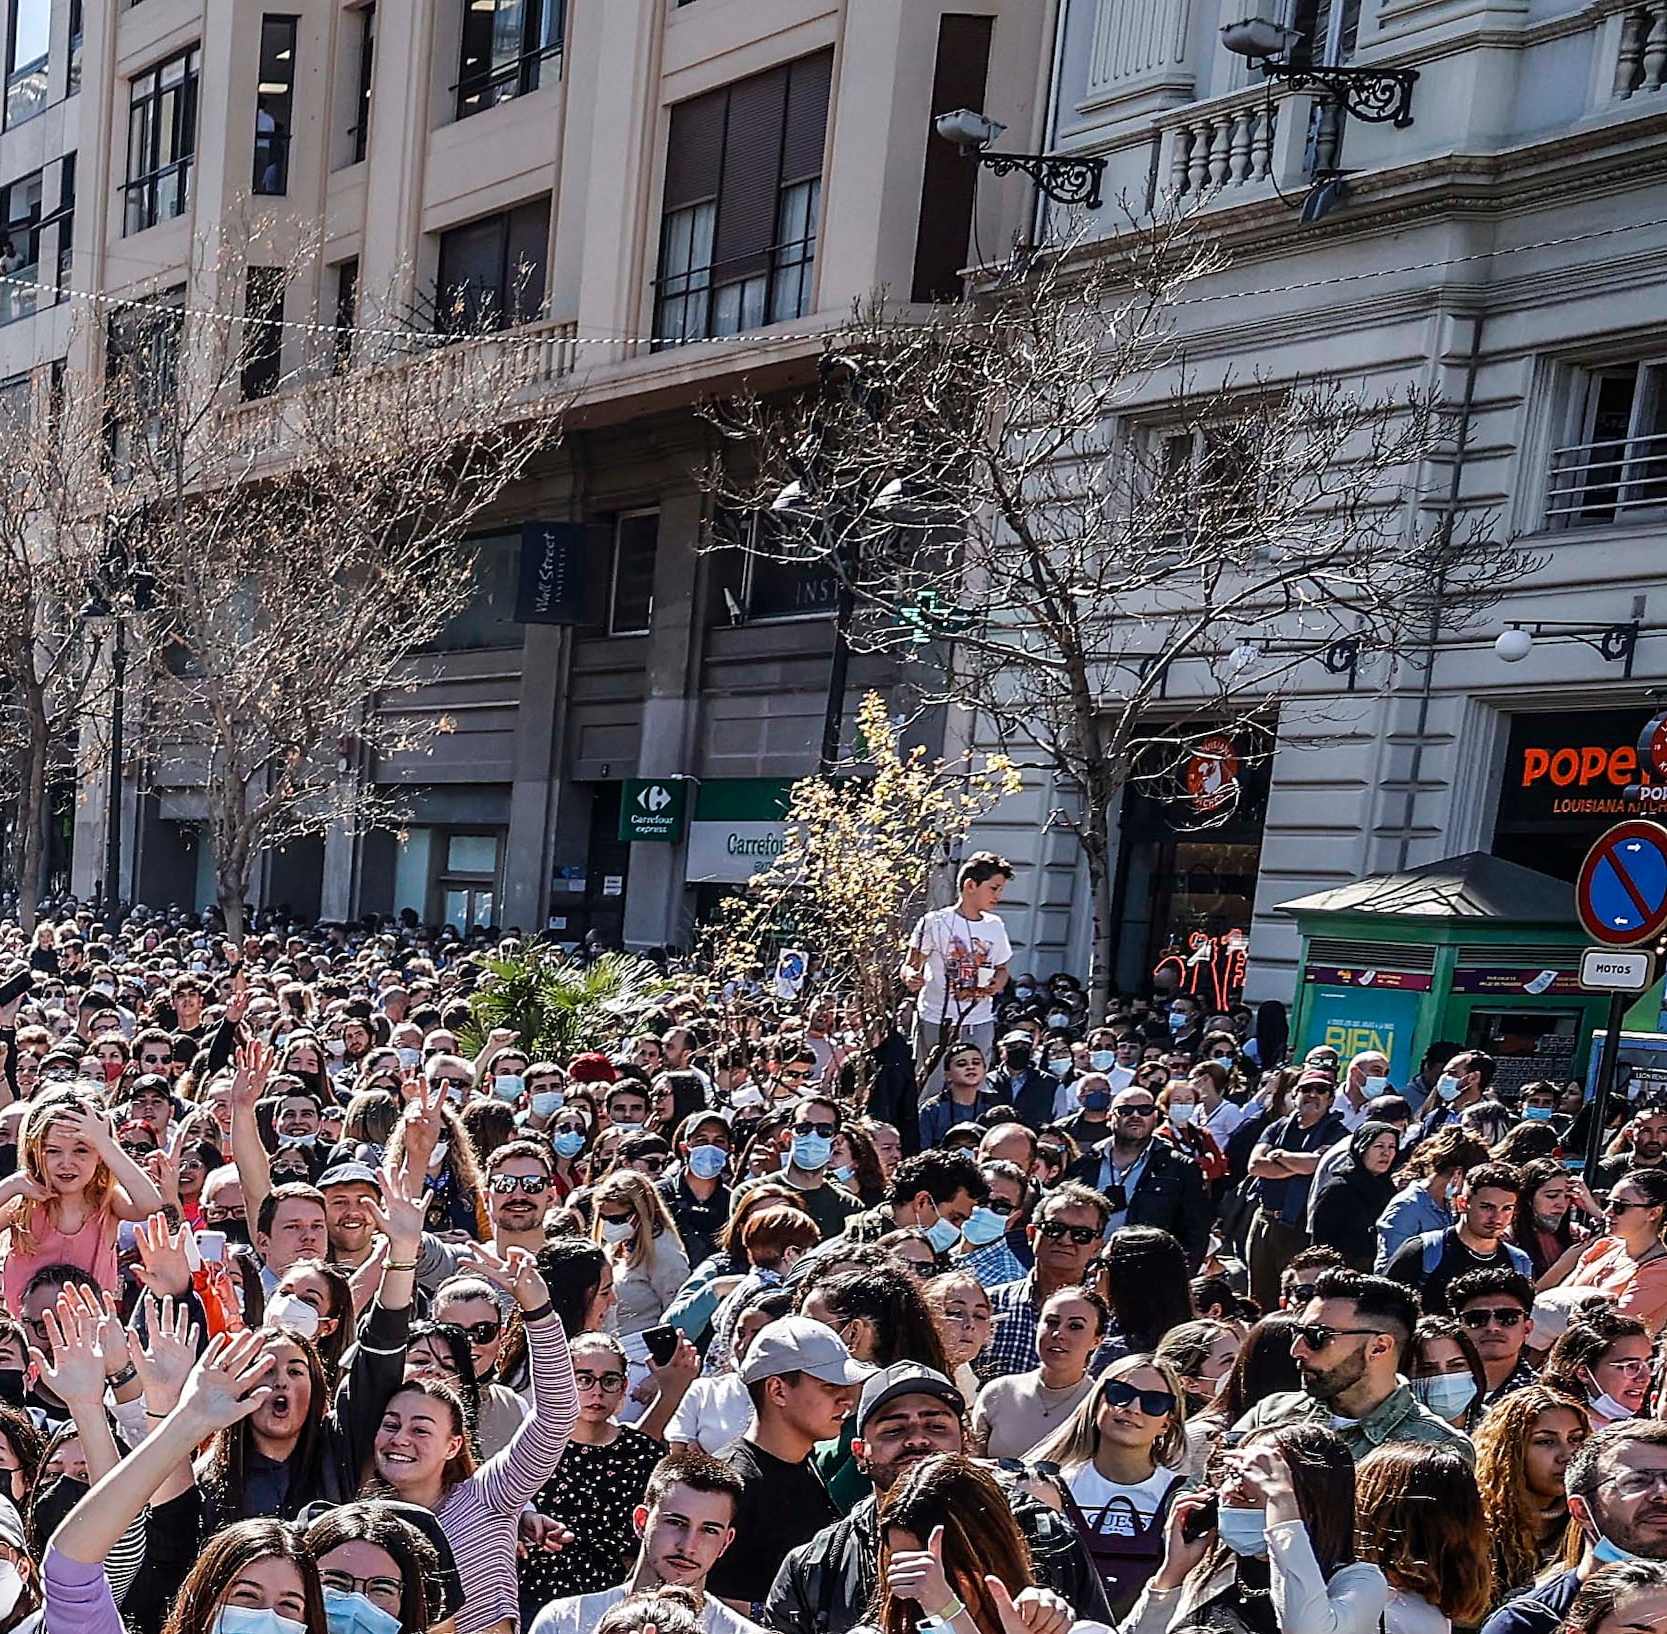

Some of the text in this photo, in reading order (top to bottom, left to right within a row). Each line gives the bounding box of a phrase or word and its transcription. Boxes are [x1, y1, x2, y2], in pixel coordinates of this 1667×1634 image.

[1553, 800, 1625, 813] LOUISIANA
[630, 814, 674, 826] Carrefour
[1595, 963, 1632, 975] MOTOS
